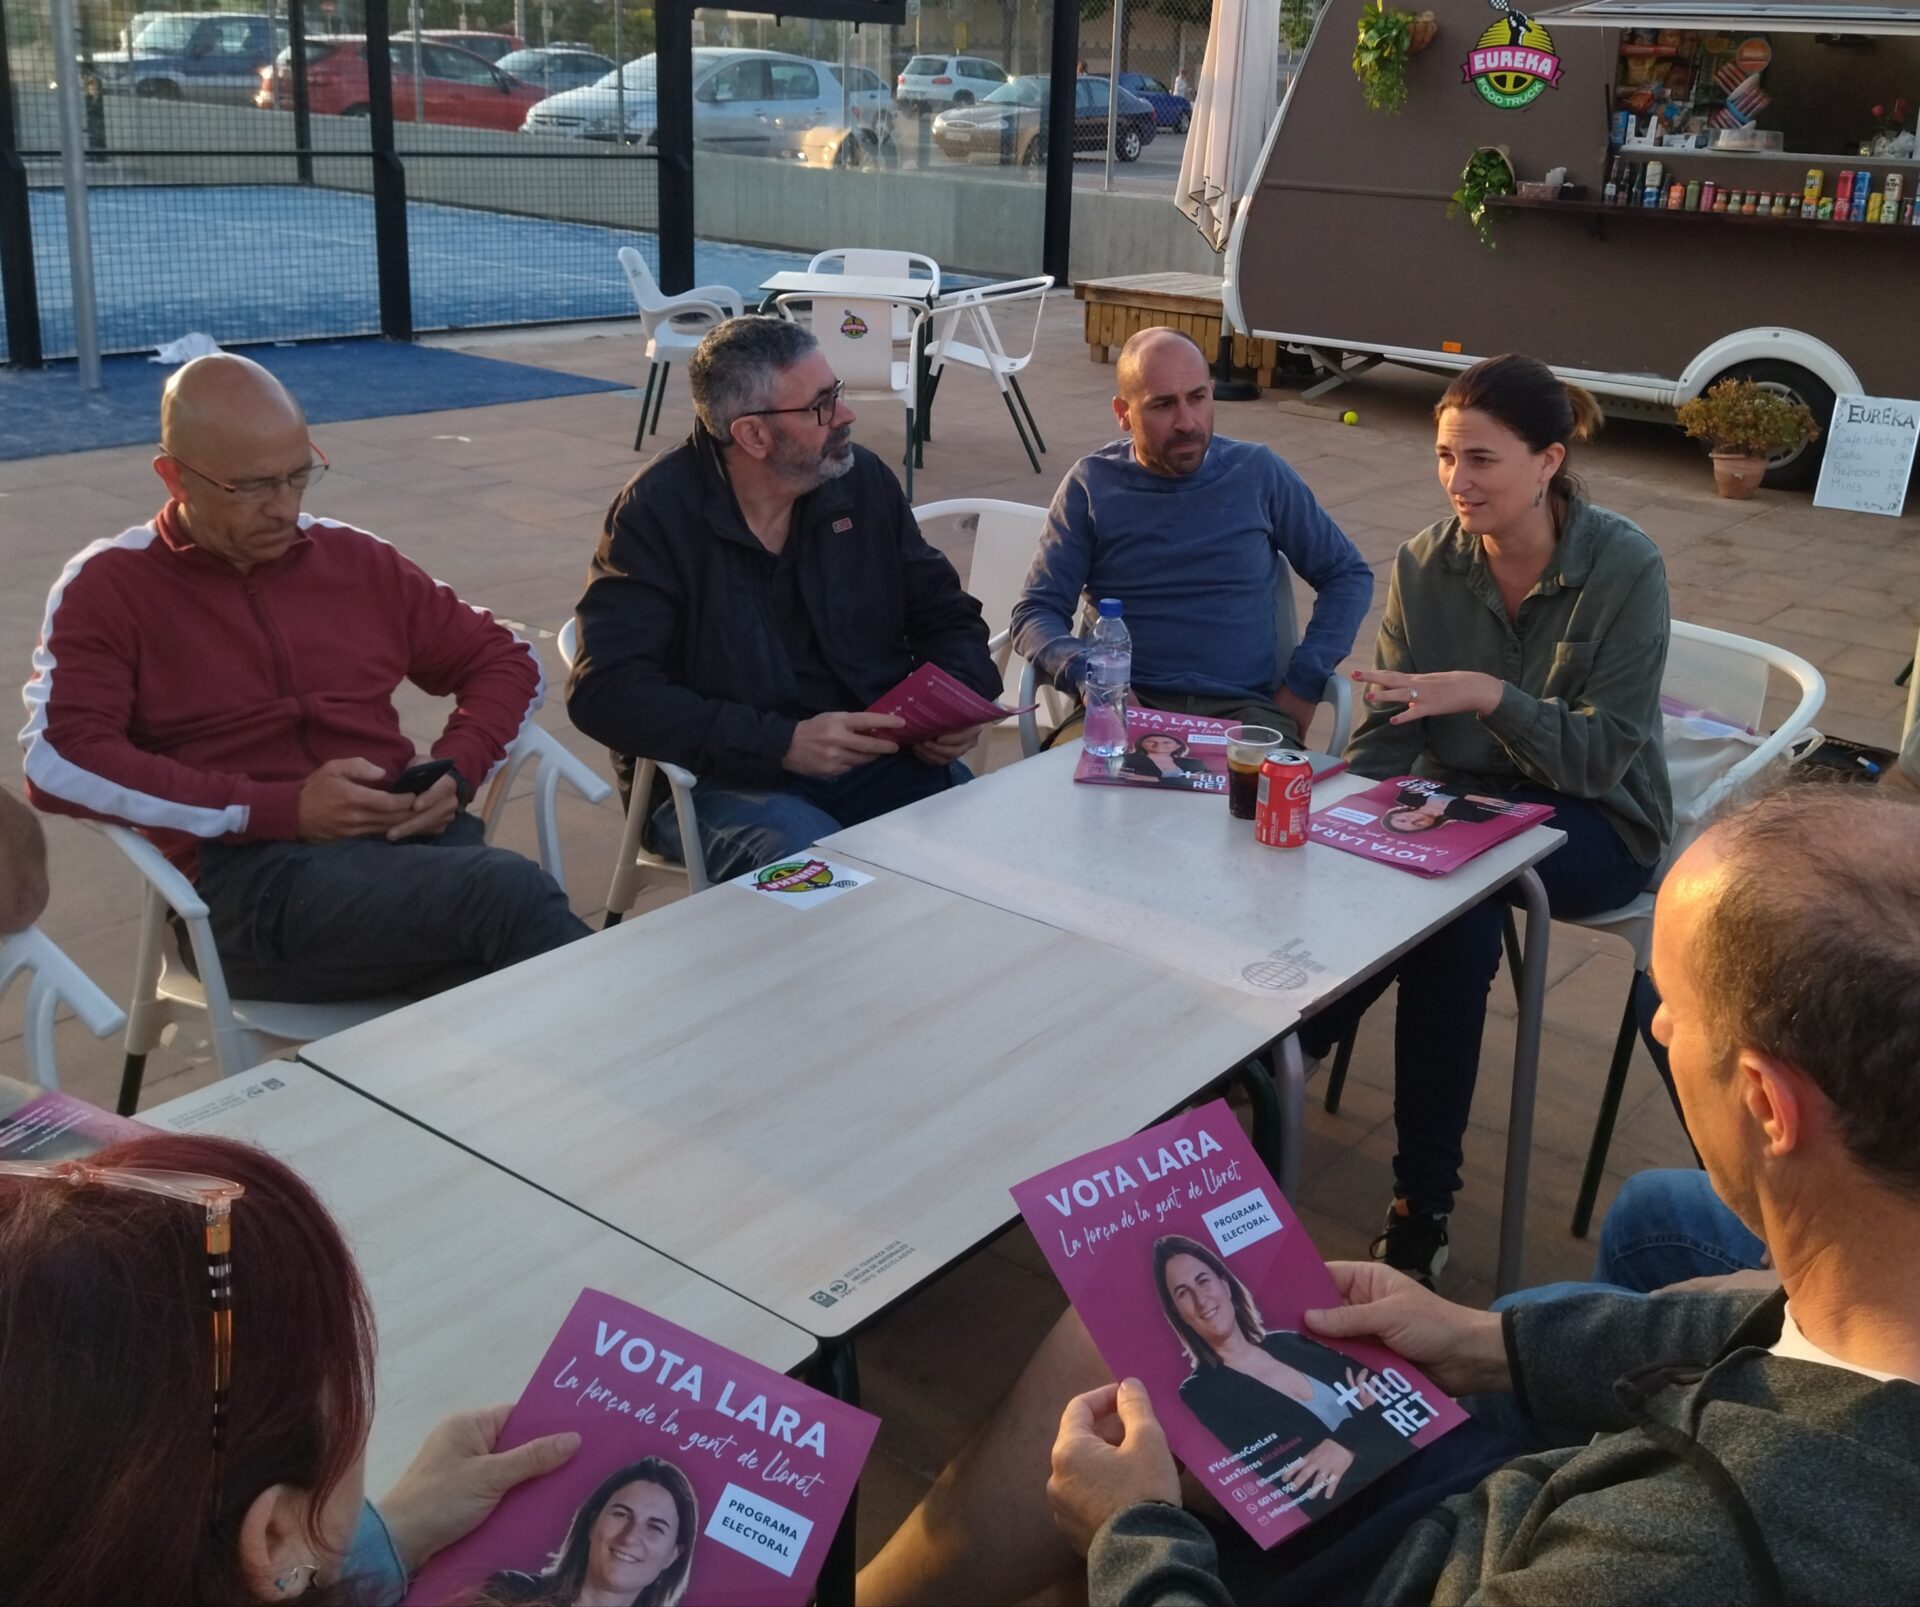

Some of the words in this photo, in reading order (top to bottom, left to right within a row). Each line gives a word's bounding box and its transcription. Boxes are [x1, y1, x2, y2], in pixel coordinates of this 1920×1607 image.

[1474, 51, 1552, 75] EUREKA
[1478, 77, 1503, 105] FOOD
[1506, 82, 1543, 106] TRUCK
[1847, 404, 1915, 430] EUREKA
[1126, 710, 1163, 722] OTA
[1171, 717, 1224, 729] LARA
[1193, 781, 1226, 790] RET
[1311, 823, 1366, 846] LARA
[1371, 842, 1427, 862] VOTA
[1045, 1165, 1139, 1217] VOTA
[1137, 1129, 1223, 1182] LARA
[1059, 1230, 1081, 1257] La
[1121, 1210, 1135, 1228] de
[1137, 1201, 1150, 1222] la
[1155, 1186, 1181, 1222] gent
[1188, 1182, 1203, 1200] de
[1213, 1201, 1263, 1229] PROGRAMA
[1221, 1214, 1270, 1242] ELECTORAL
[594, 1320, 702, 1402] VOTA
[715, 1380, 826, 1458] LARA
[554, 1356, 578, 1389] La
[576, 1377, 631, 1412] força
[634, 1403, 656, 1425] de
[660, 1408, 680, 1435] la
[679, 1432, 738, 1458] gent
[737, 1449, 759, 1469] de
[761, 1451, 825, 1497] Lloret
[1381, 1390, 1440, 1437] RET
[1208, 1432, 1278, 1473] #YoSumoConLara
[728, 1499, 797, 1540] PROGRAMA
[721, 1516, 788, 1557] ELECTORAL
